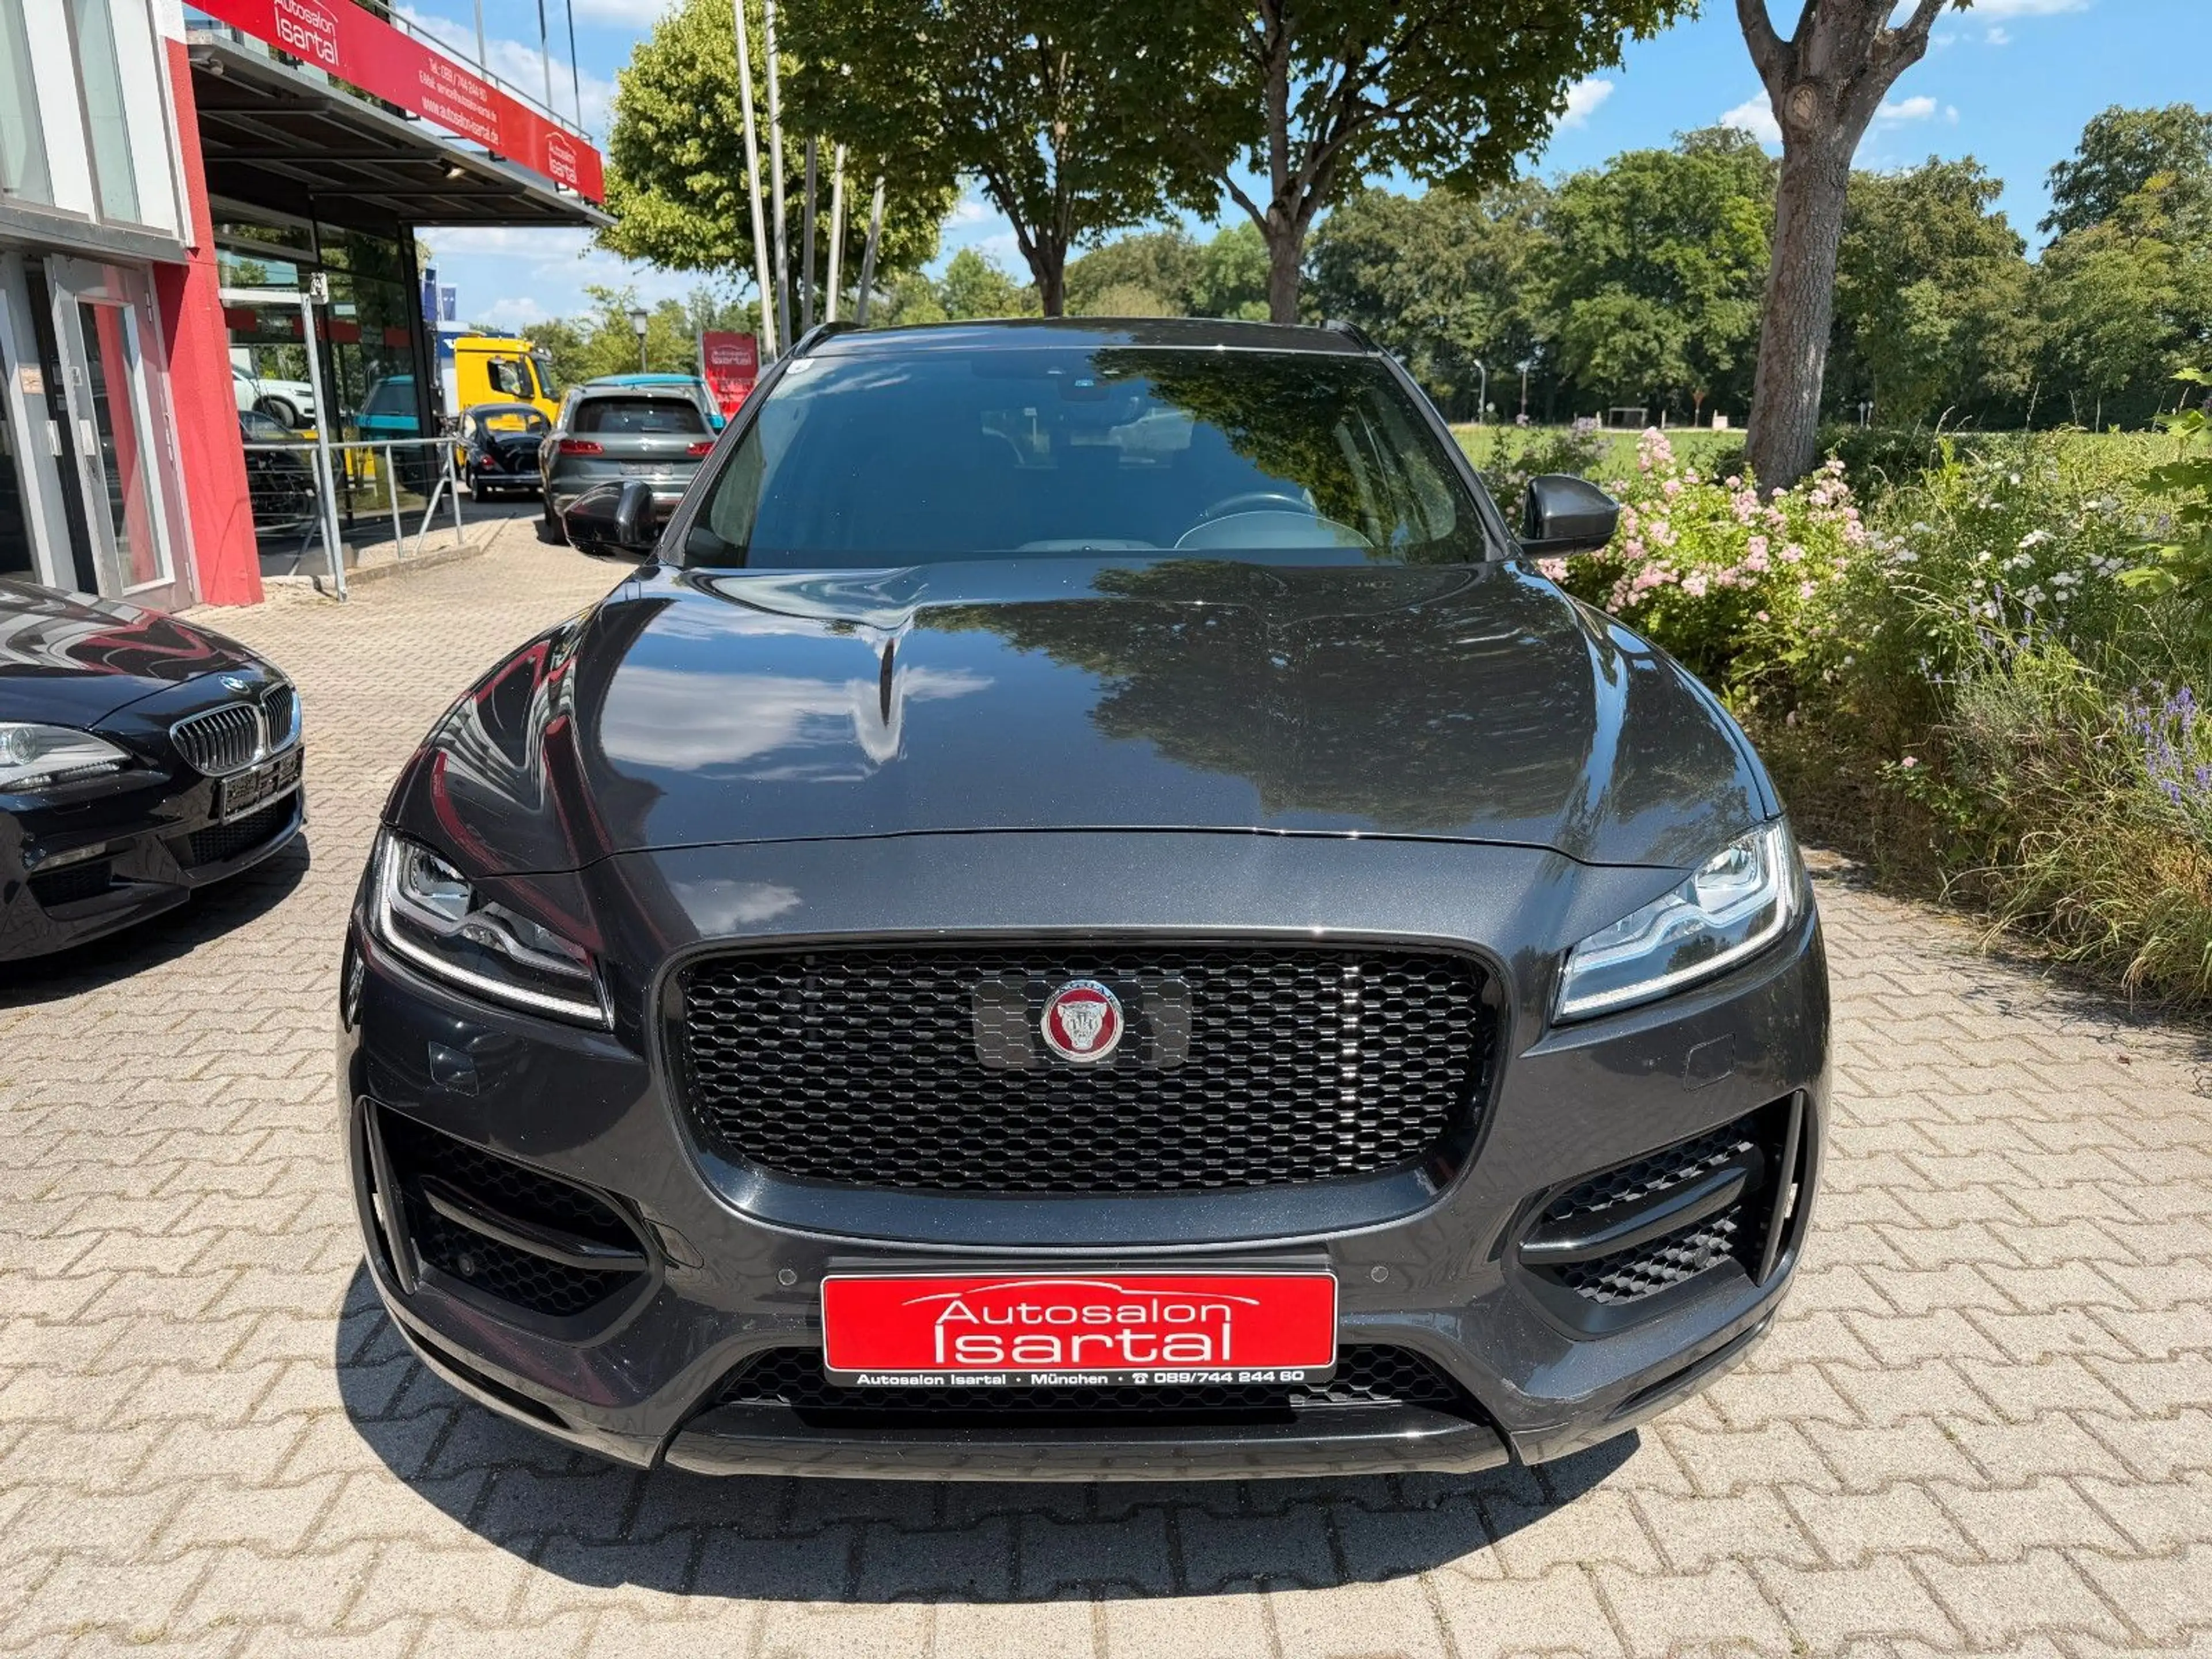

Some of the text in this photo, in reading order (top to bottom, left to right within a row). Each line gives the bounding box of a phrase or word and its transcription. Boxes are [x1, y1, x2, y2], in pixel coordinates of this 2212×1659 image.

[274, 6, 339, 67] Isartal
[549, 152, 577, 185] Isartal
[936, 1298, 1232, 1325] Autosalon
[935, 1323, 1231, 1363] Isartal
[857, 1374, 944, 1385] Autosalon
[951, 1374, 1006, 1385] Isartal
[1031, 1373, 1108, 1384] München
[1154, 1372, 1233, 1383] 089/744
[1238, 1372, 1275, 1382] 244
